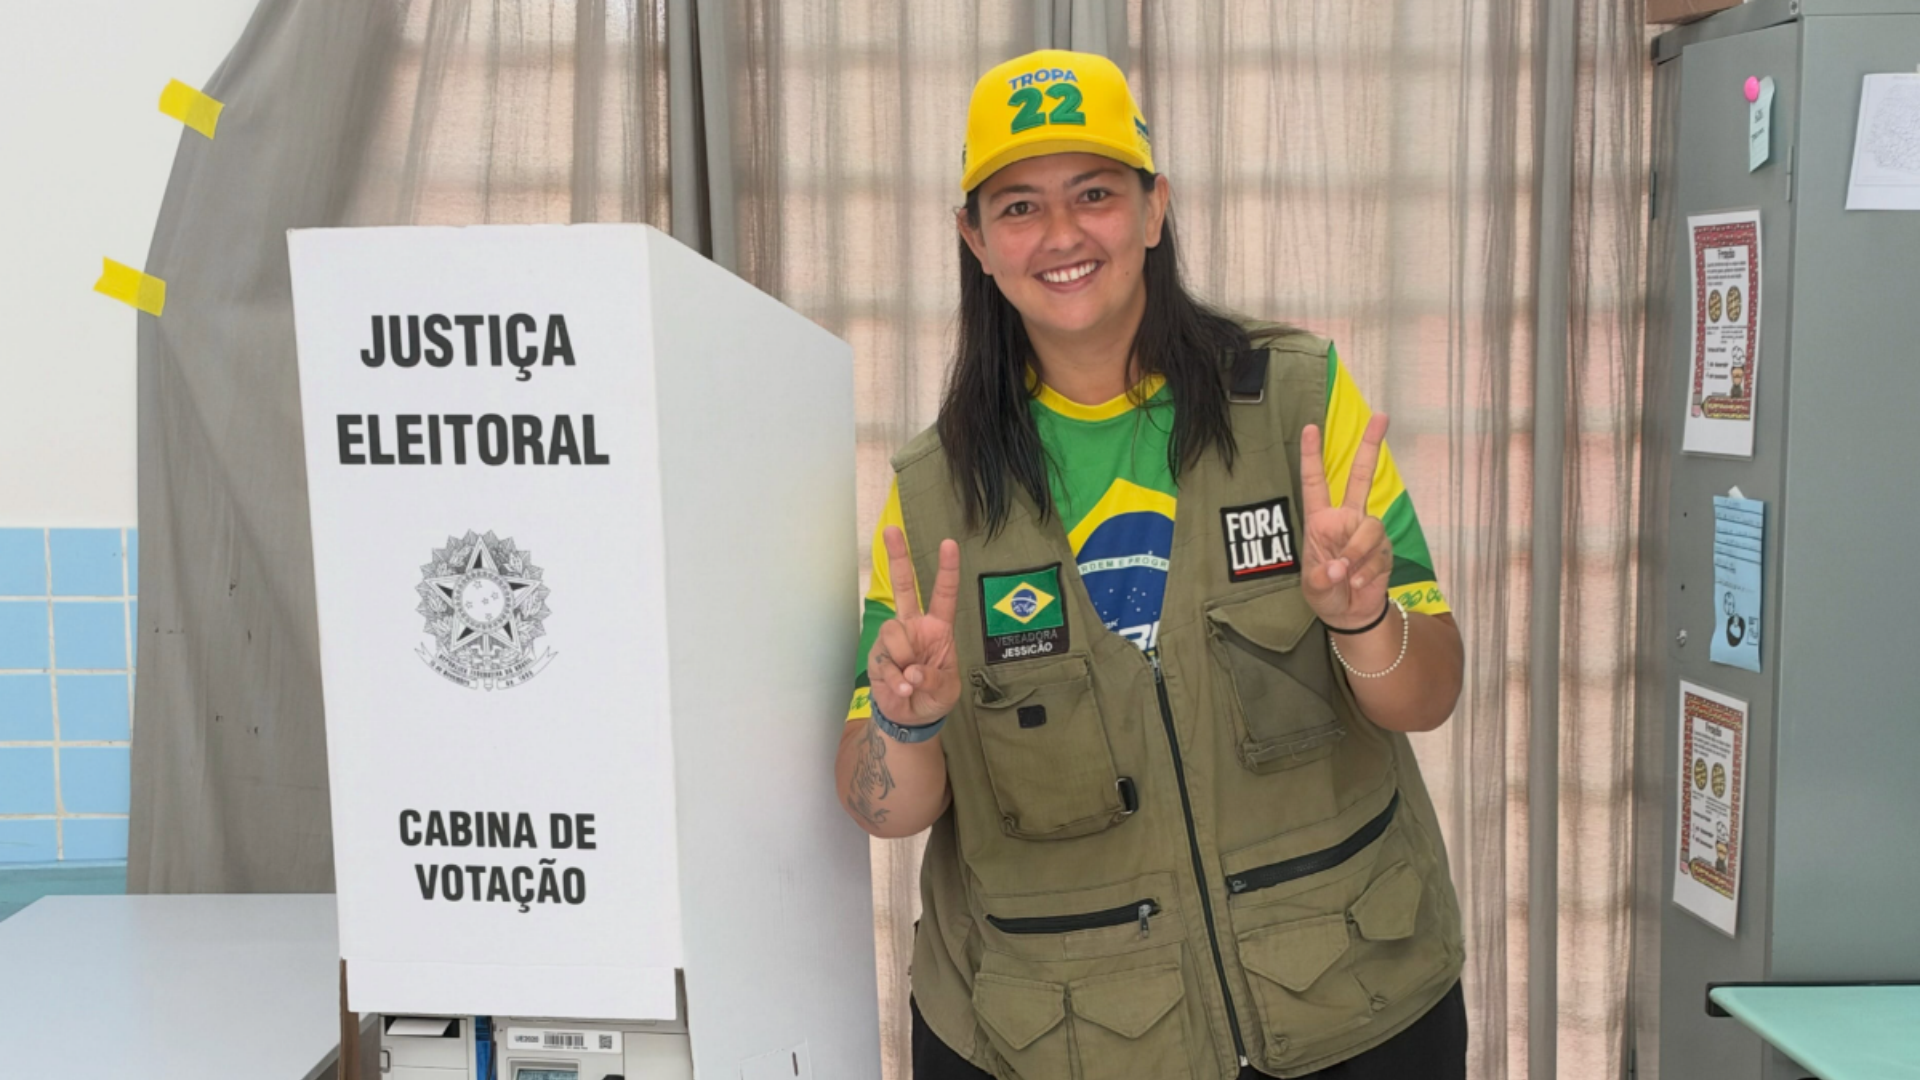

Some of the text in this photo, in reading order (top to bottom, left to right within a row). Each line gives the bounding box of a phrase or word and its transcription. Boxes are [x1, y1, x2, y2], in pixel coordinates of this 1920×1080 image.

[1008, 68, 1078, 90] TROPA
[1007, 83, 1086, 135] 22
[360, 312, 576, 382] JUSTIÇA
[336, 413, 610, 466] ELEITORAL
[1225, 504, 1288, 542] FORA
[1081, 560, 1114, 573] RDEM
[1128, 556, 1167, 569] PROGR
[1229, 533, 1293, 571] LULA!
[994, 629, 1058, 647] VEREADORA
[1002, 640, 1053, 659] JESSICÃO
[399, 809, 597, 850] CABINA DE
[415, 857, 586, 913] VOTAÇÃO
